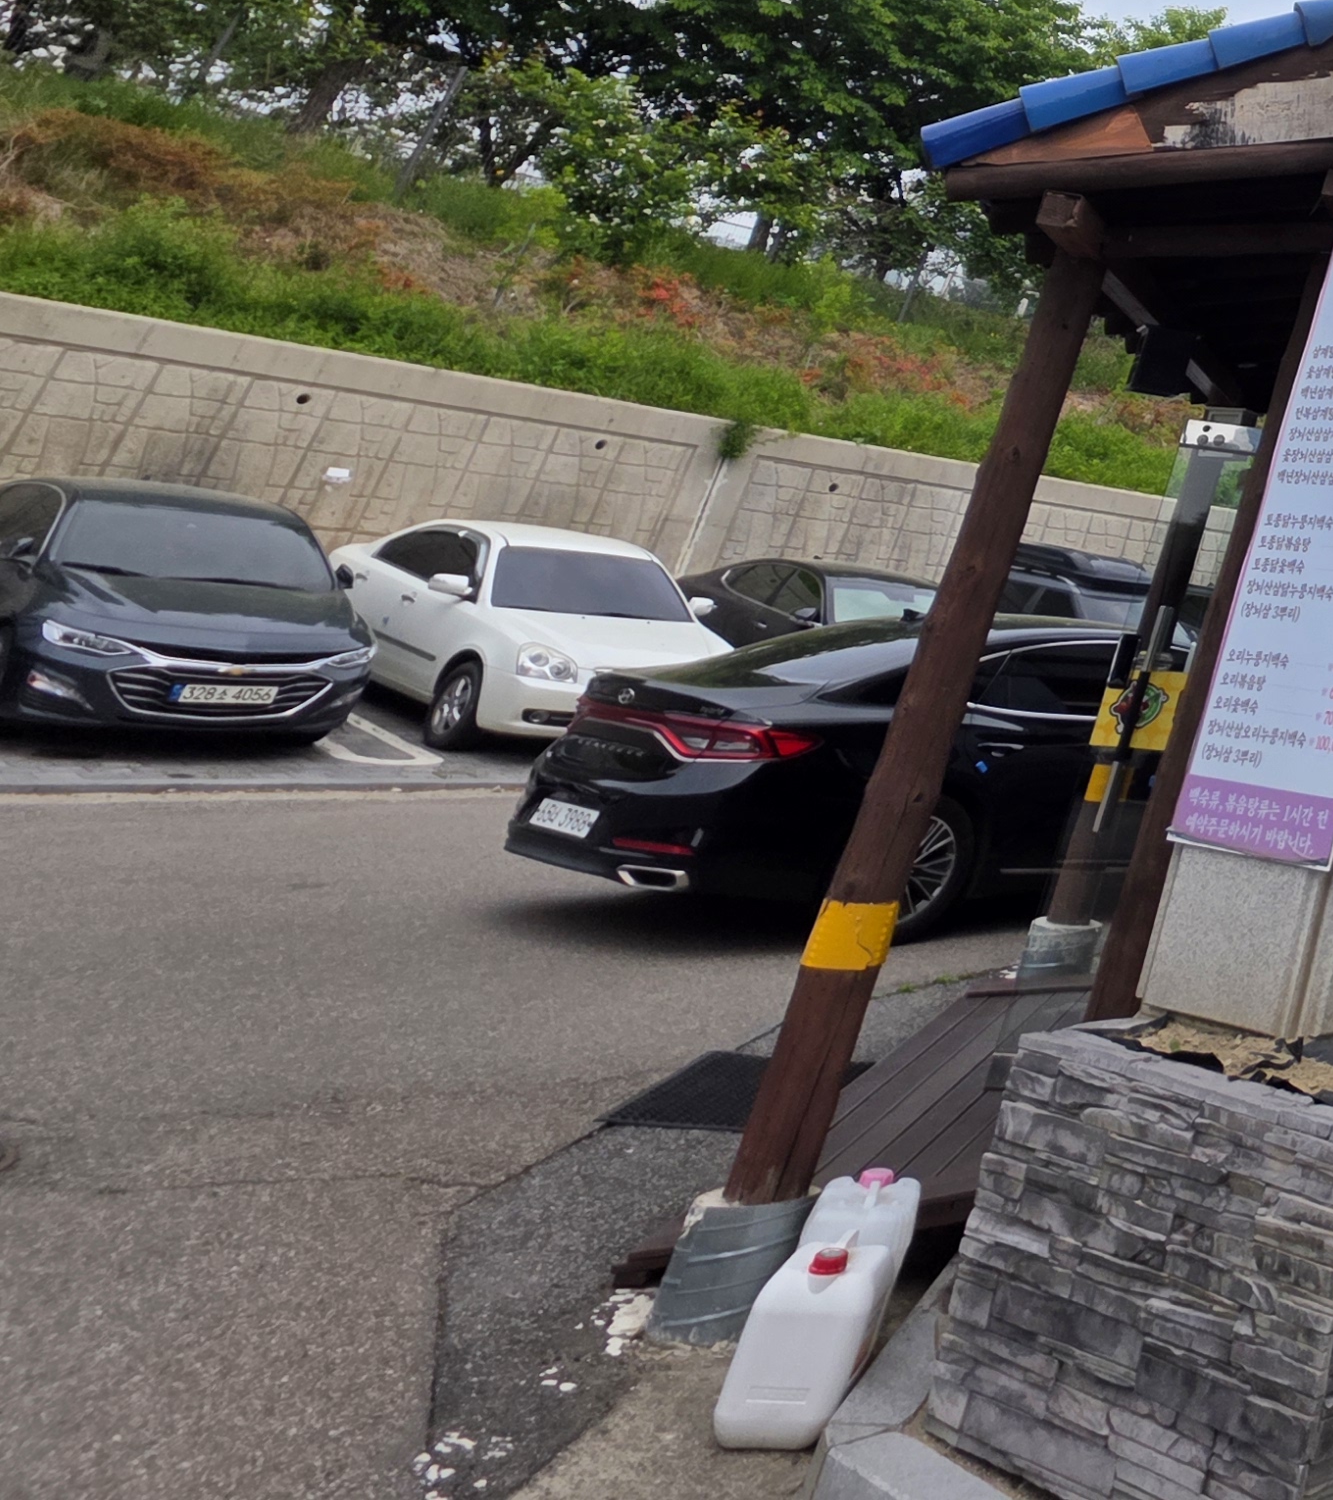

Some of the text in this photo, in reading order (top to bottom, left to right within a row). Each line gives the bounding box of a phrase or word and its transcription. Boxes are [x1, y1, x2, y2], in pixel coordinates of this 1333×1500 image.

[1226, 649, 1289, 669] 오리누룽지백숙
[183, 686, 272, 702] 328소 4056
